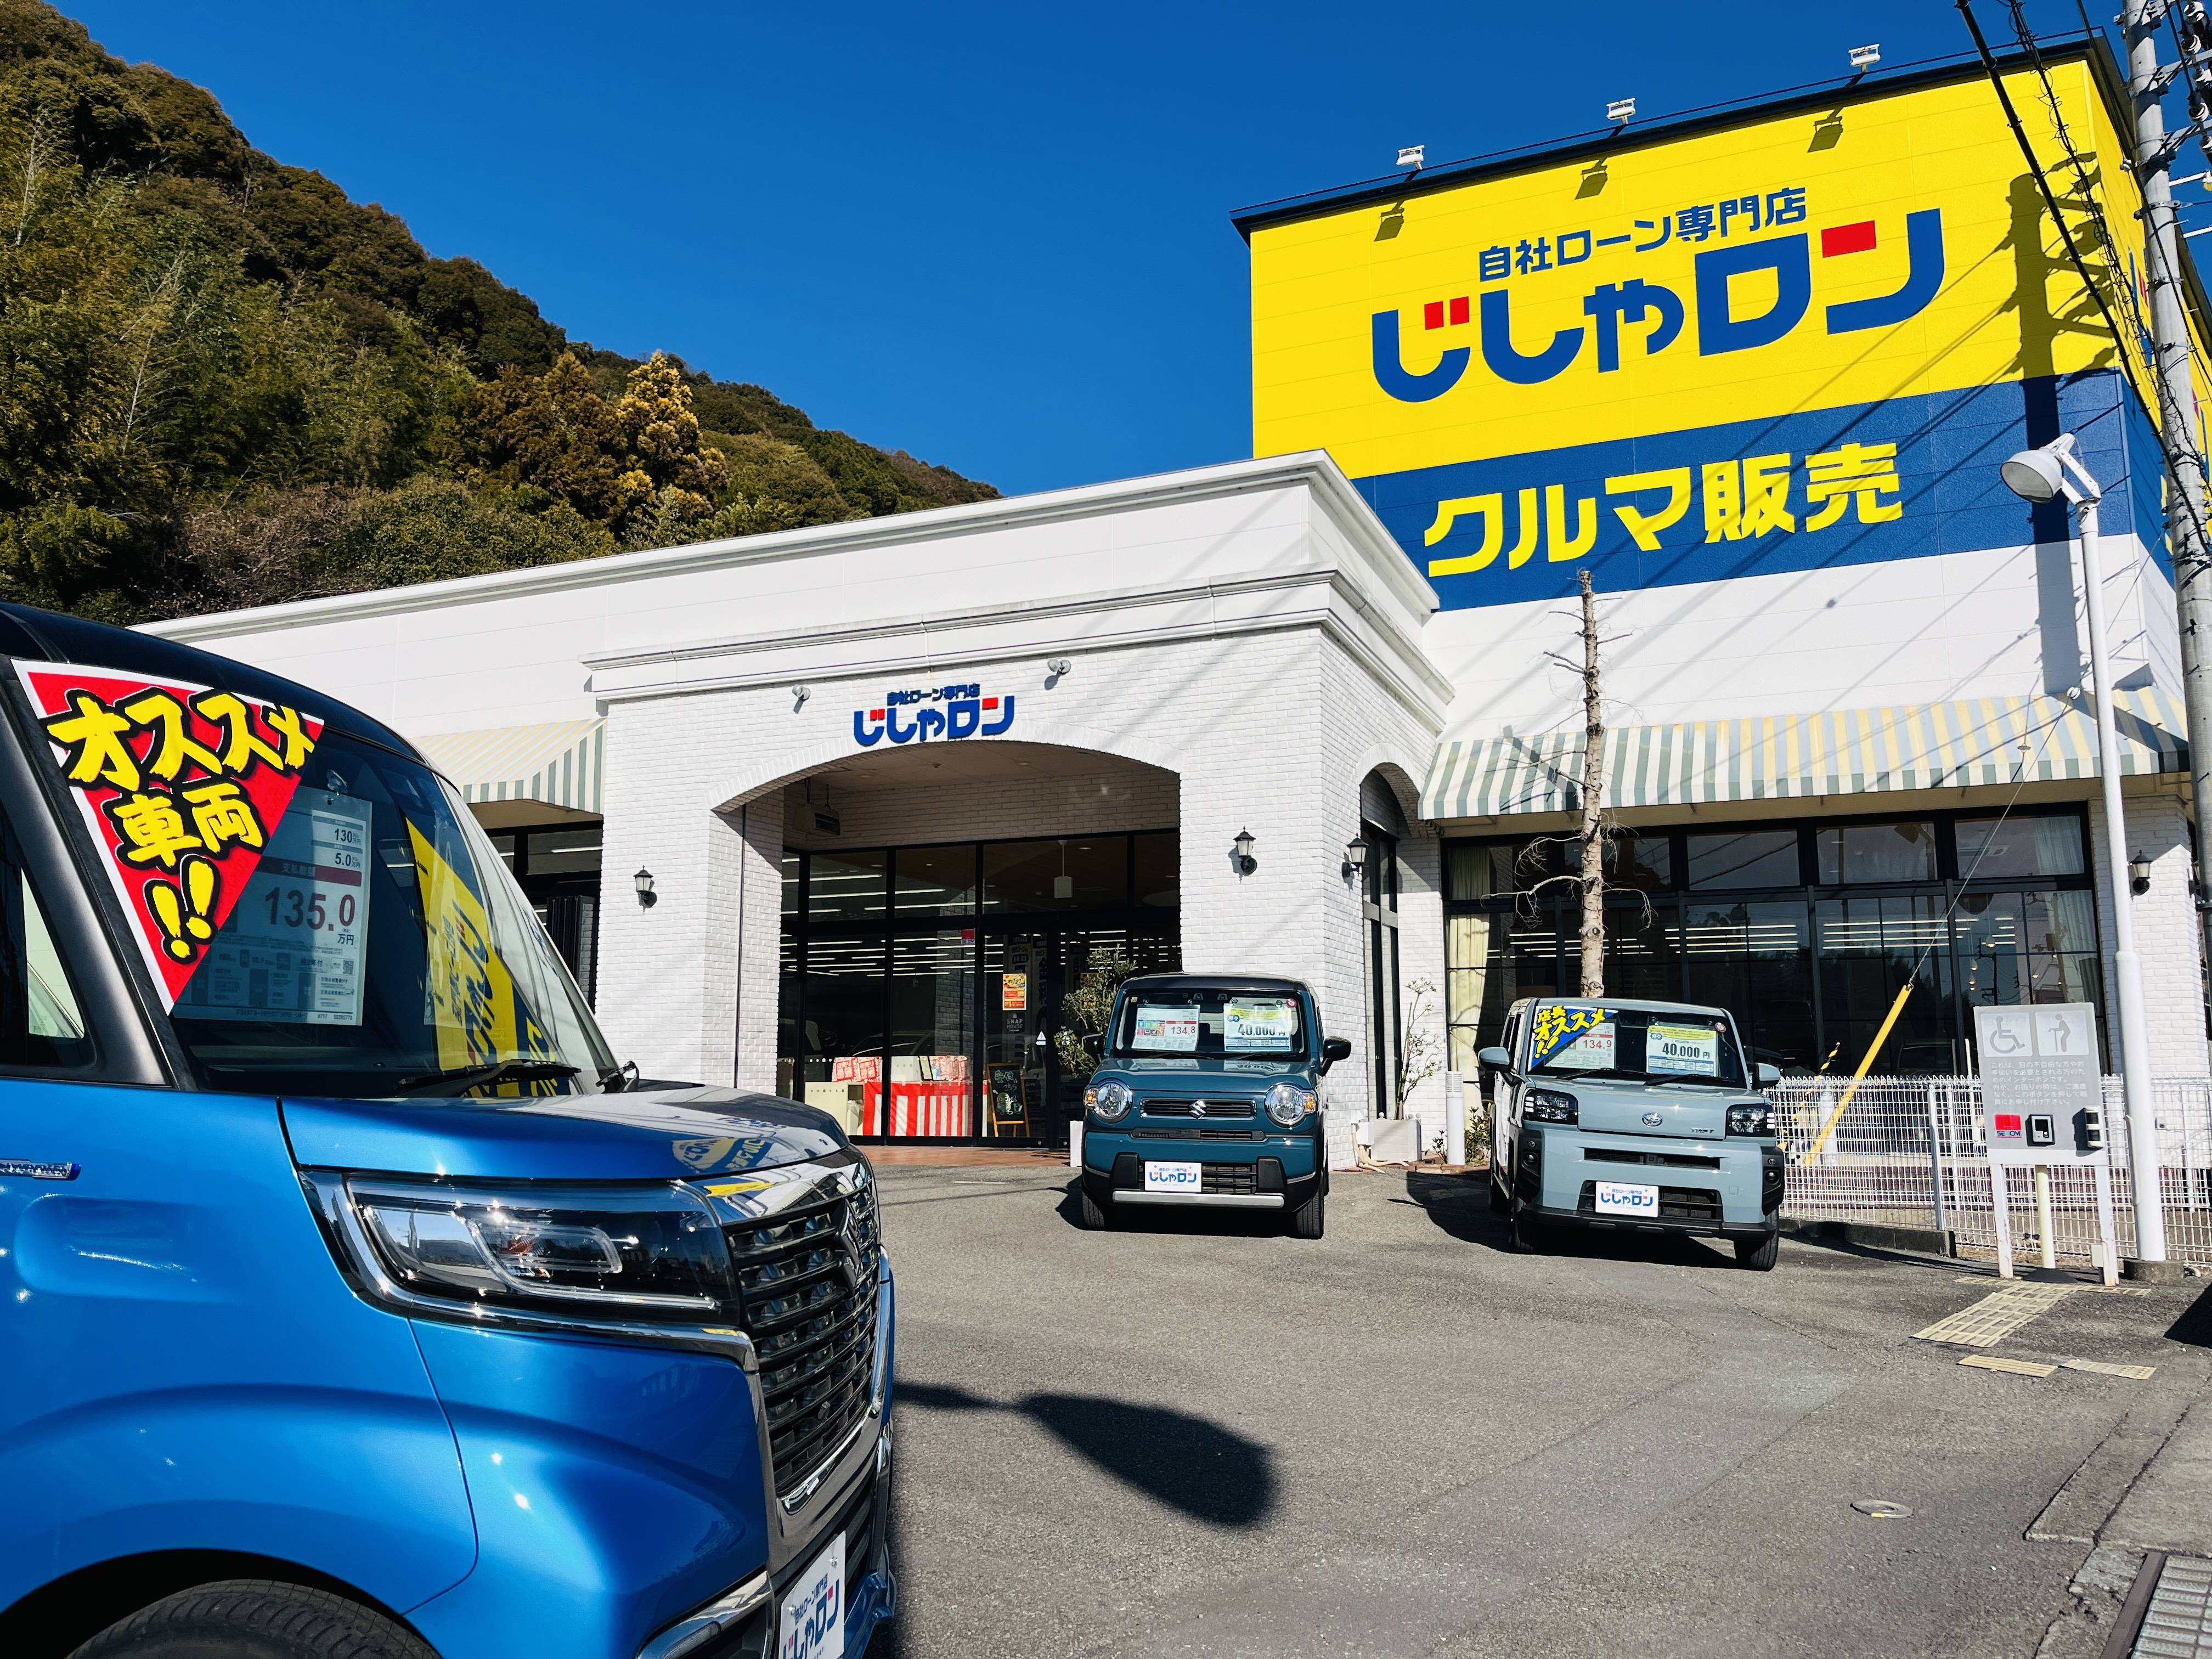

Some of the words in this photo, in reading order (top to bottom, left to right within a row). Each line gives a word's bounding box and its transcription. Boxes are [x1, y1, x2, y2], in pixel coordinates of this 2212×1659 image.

[1479, 187, 1806, 282] 自社ローン専門店
[1372, 207, 1945, 403] じしゃロン
[1424, 442, 1903, 578] クルマ販売
[887, 683, 980, 707] 自社ローン専門店
[854, 695, 1015, 747] じしゃロン
[46, 692, 316, 792] オススメ
[113, 782, 264, 868] 車両
[265, 887, 356, 932] 135.0
[337, 933, 354, 945] 万円
[1534, 1008, 1605, 1041] オススメ
[1537, 1006, 1566, 1023] 店長
[1171, 1026, 1196, 1035] 134.8
[1583, 1040, 1612, 1049] 134.9
[1662, 1043, 1700, 1058] 40,000
[1149, 1171, 1197, 1182] じしゃロン
[1600, 1193, 1653, 1206] じしゃロン
